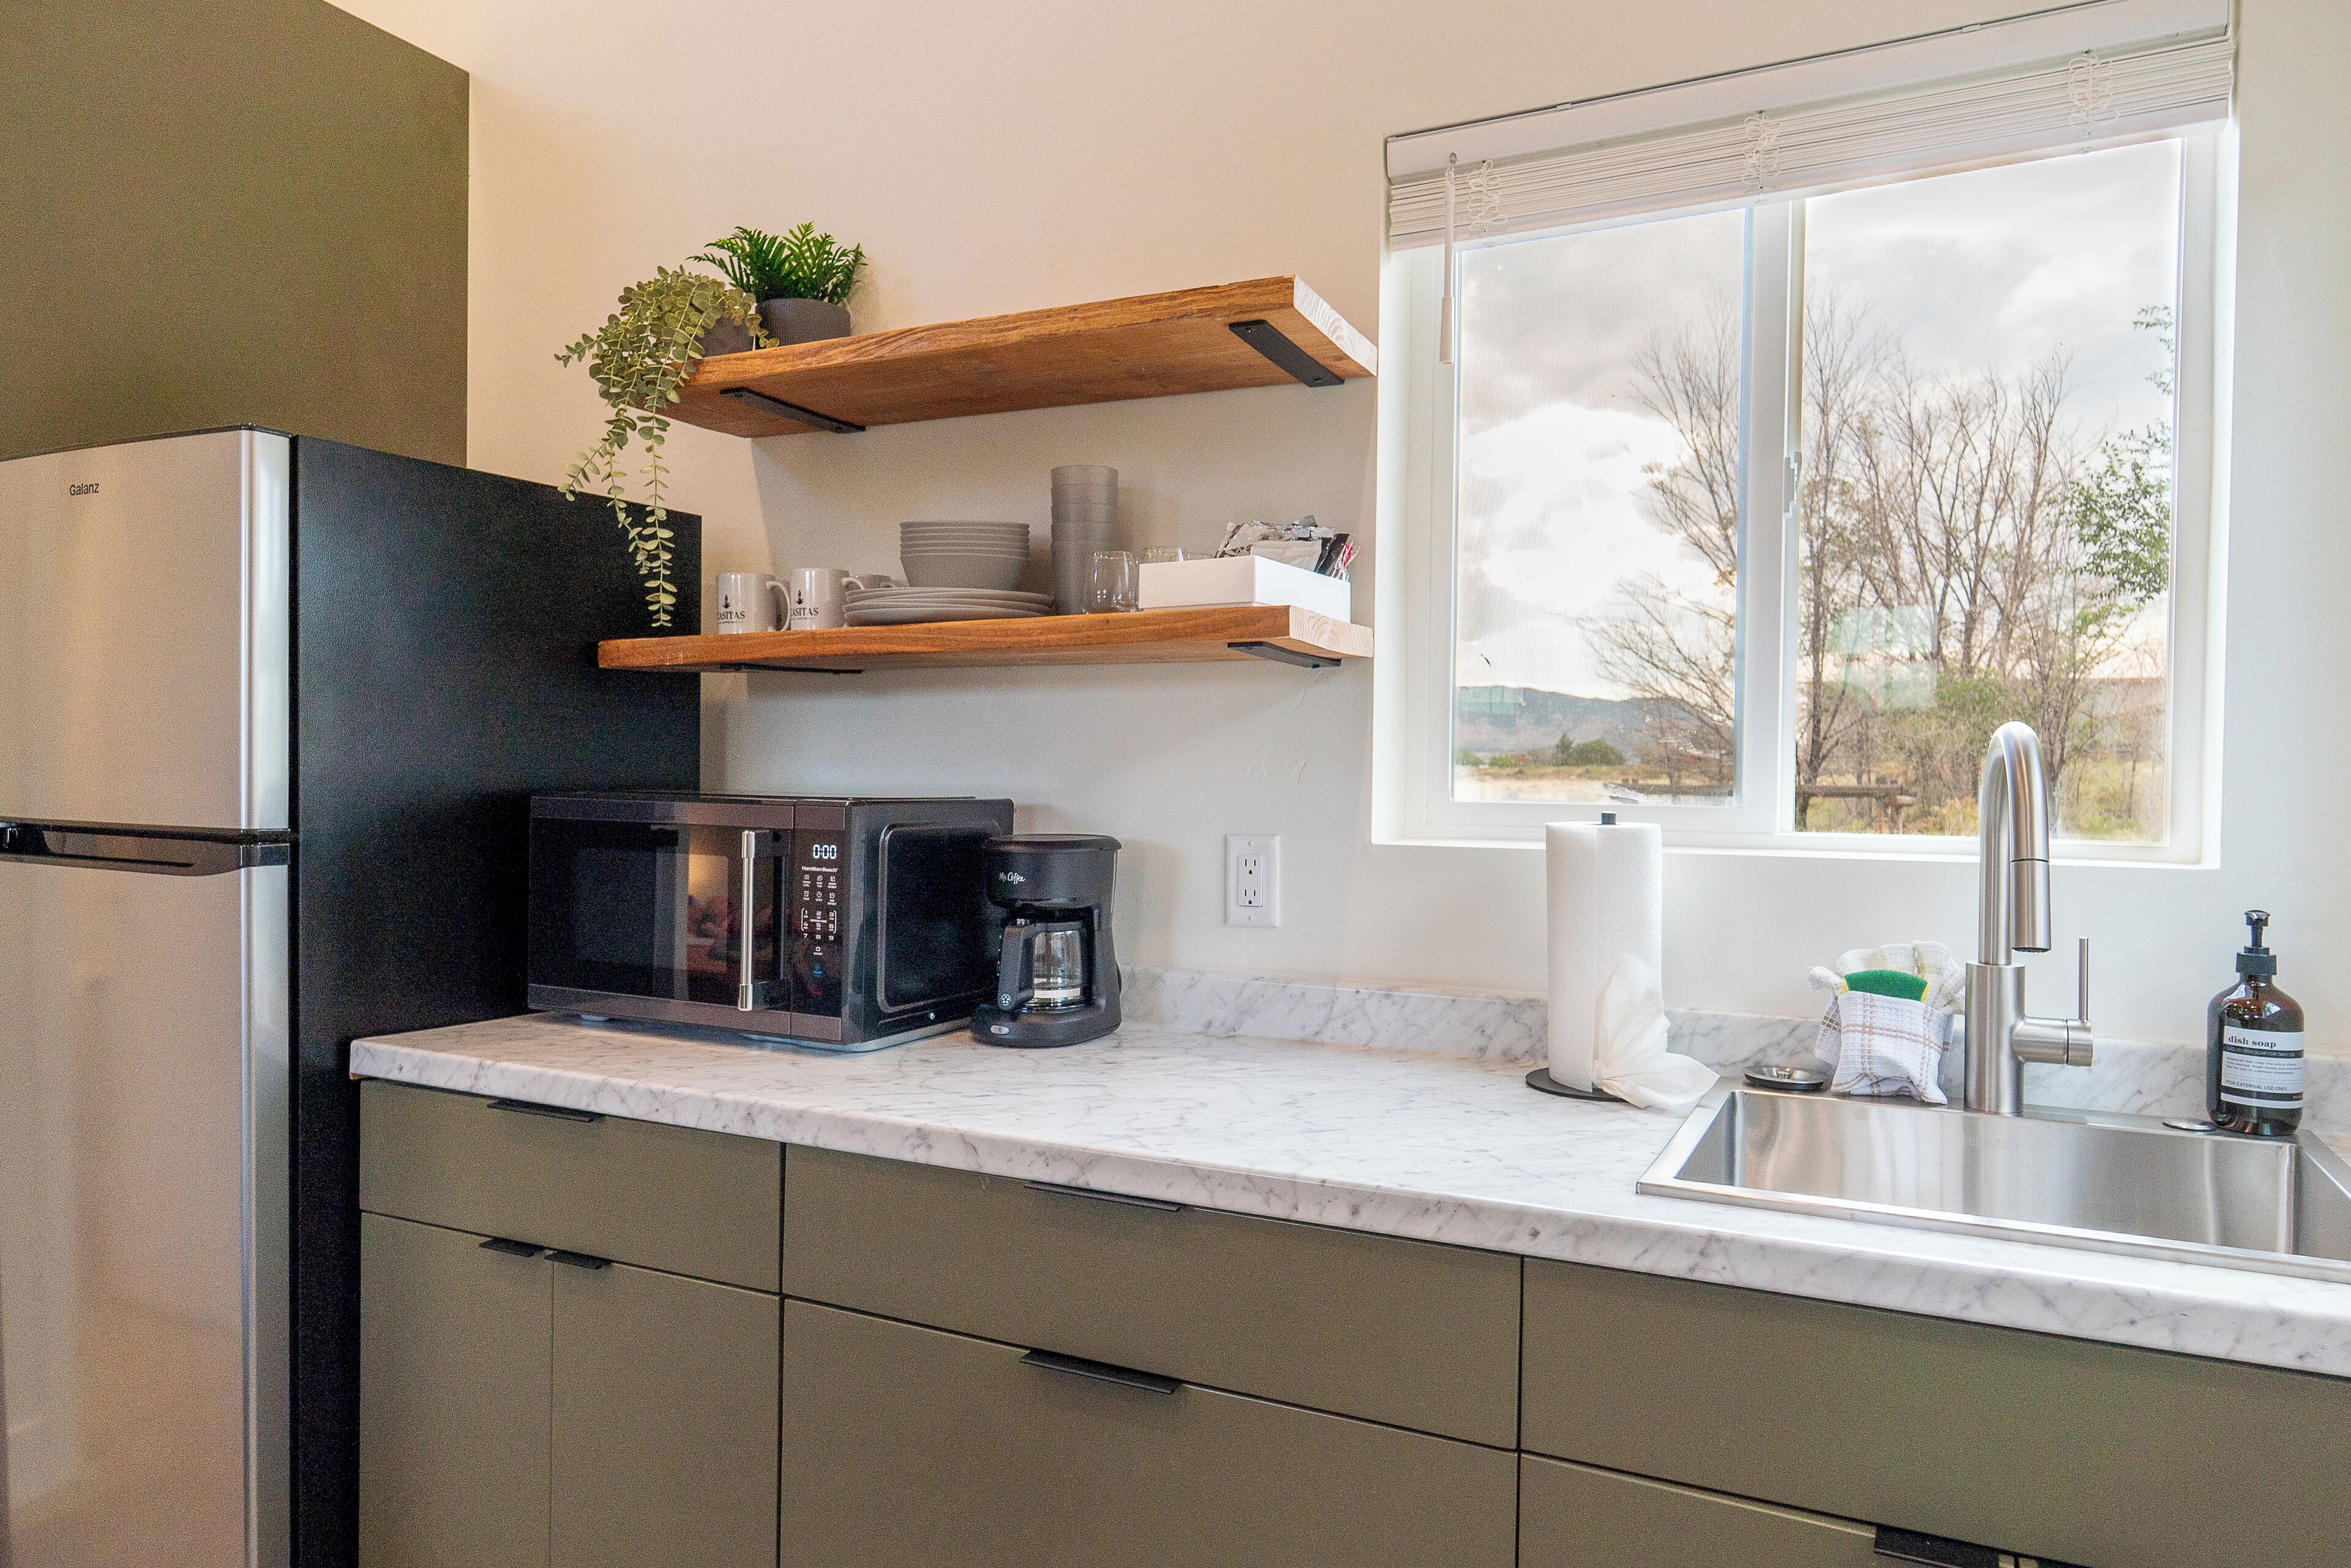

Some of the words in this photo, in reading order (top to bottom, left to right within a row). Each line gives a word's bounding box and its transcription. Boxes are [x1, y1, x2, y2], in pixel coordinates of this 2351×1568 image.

[69, 483, 99, 495] Galanz
[813, 844, 836, 859] 0:00
[1007, 872, 1026, 884] Coffee
[2228, 1036, 2249, 1045] dish
[2252, 1040, 2276, 1049] soap
